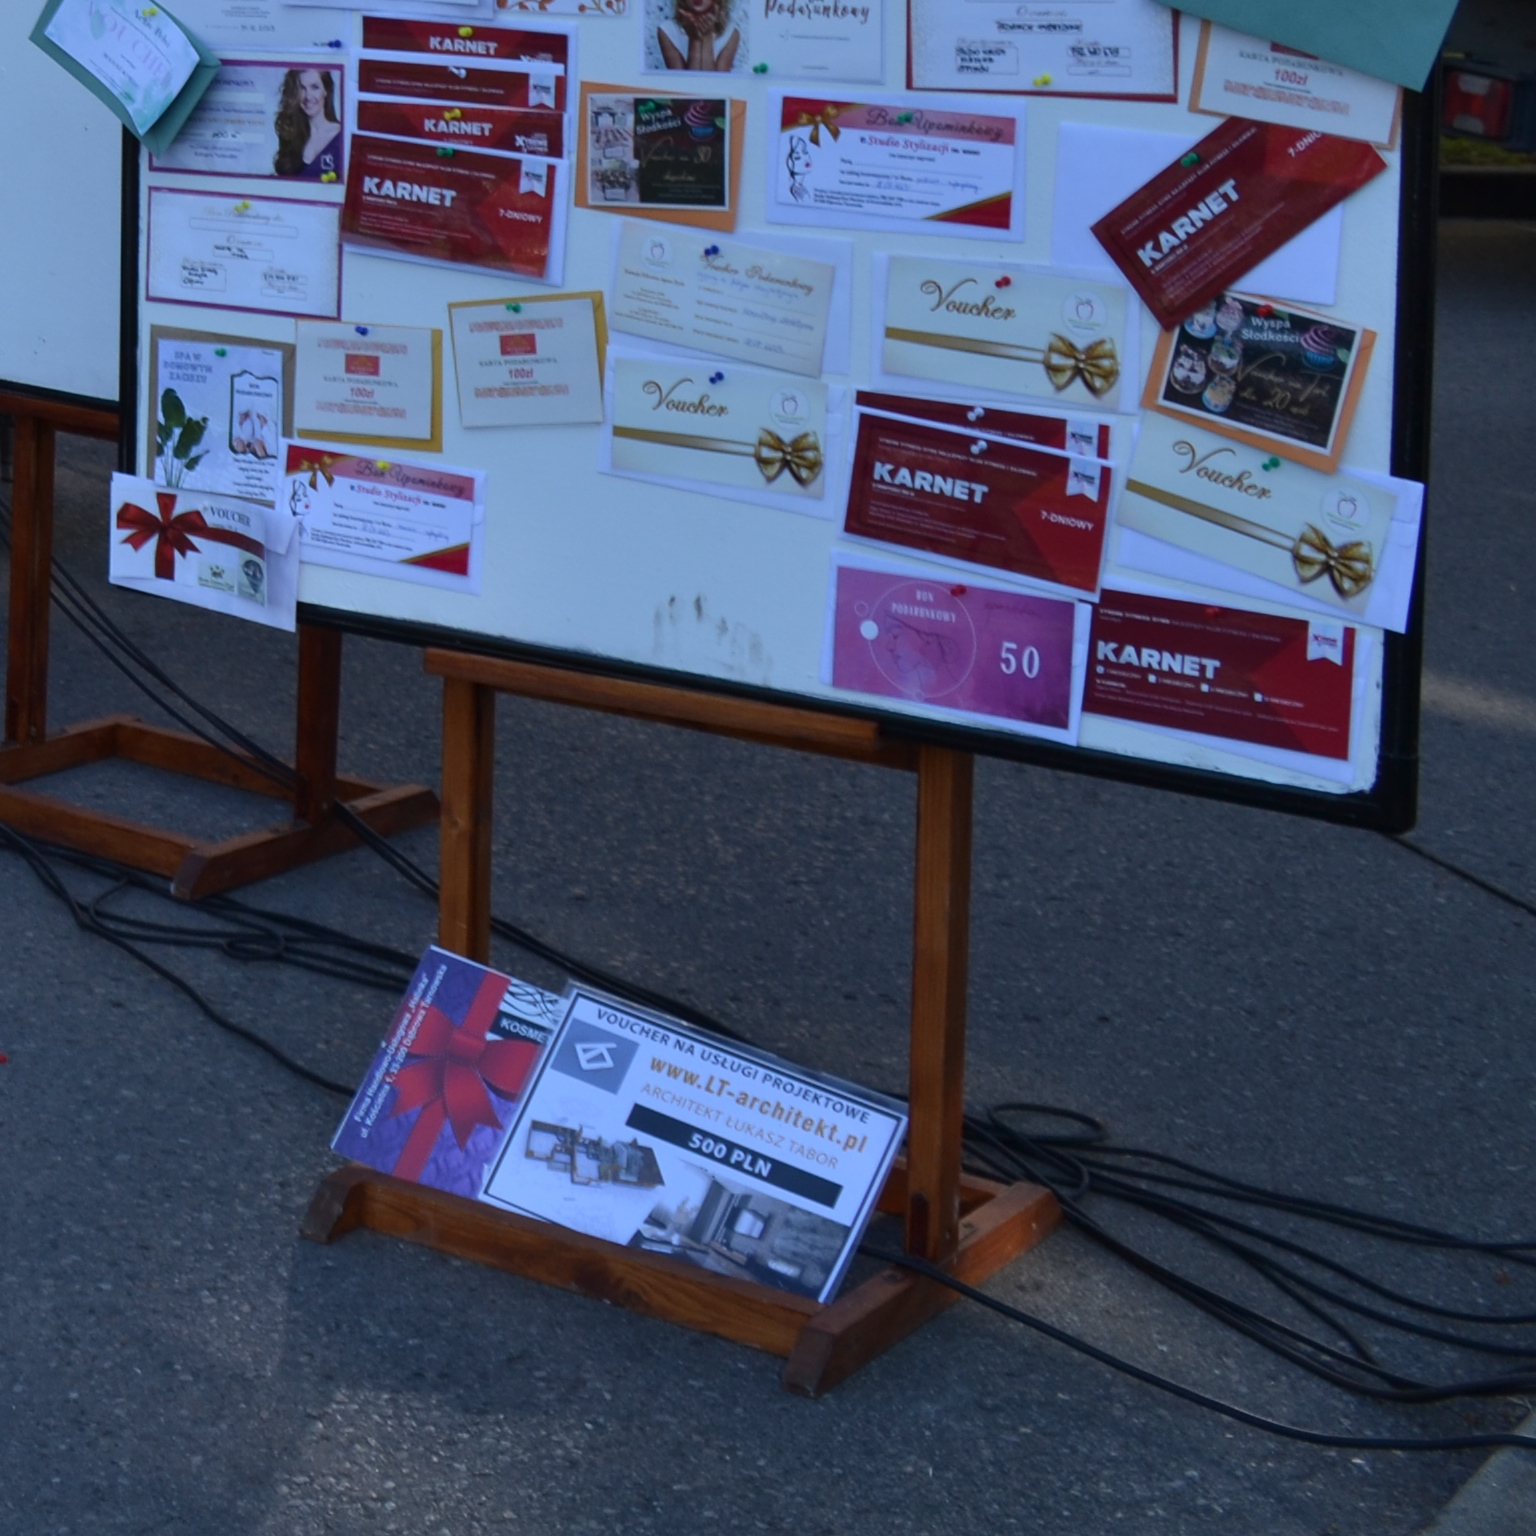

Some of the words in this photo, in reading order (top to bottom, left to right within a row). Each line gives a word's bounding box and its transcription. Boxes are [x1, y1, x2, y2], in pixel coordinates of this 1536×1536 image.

[429, 35, 498, 55] KARNET
[424, 117, 493, 137] KARNET
[866, 135, 900, 149] Studio
[903, 138, 949, 156] Stylizacji
[362, 175, 458, 208] KARNET
[1136, 178, 1241, 270] KARNET
[919, 276, 1018, 322] Voucher
[1241, 328, 1302, 344] Słodkości
[1251, 314, 1293, 331] Wyspa
[641, 376, 730, 419] Voucher
[872, 460, 990, 505] KARNET
[1171, 439, 1274, 501] Voucher
[209, 504, 253, 528] VOUCHER
[999, 640, 1041, 679] 50
[1096, 639, 1222, 681] KARNET
[596, 1007, 671, 1050] VOUCHER
[673, 1037, 696, 1058] NA
[699, 1046, 760, 1081] USŁUGI
[762, 1073, 871, 1127] PROJEKTOWE
[640, 1081, 725, 1123] ARCHITEKT
[726, 1114, 787, 1148] ŁUKASZ
[788, 1138, 841, 1171] TABOR
[649, 1056, 869, 1155] www.LT-architekt.pl
[687, 1131, 729, 1161] 500
[730, 1144, 774, 1179] PLN
